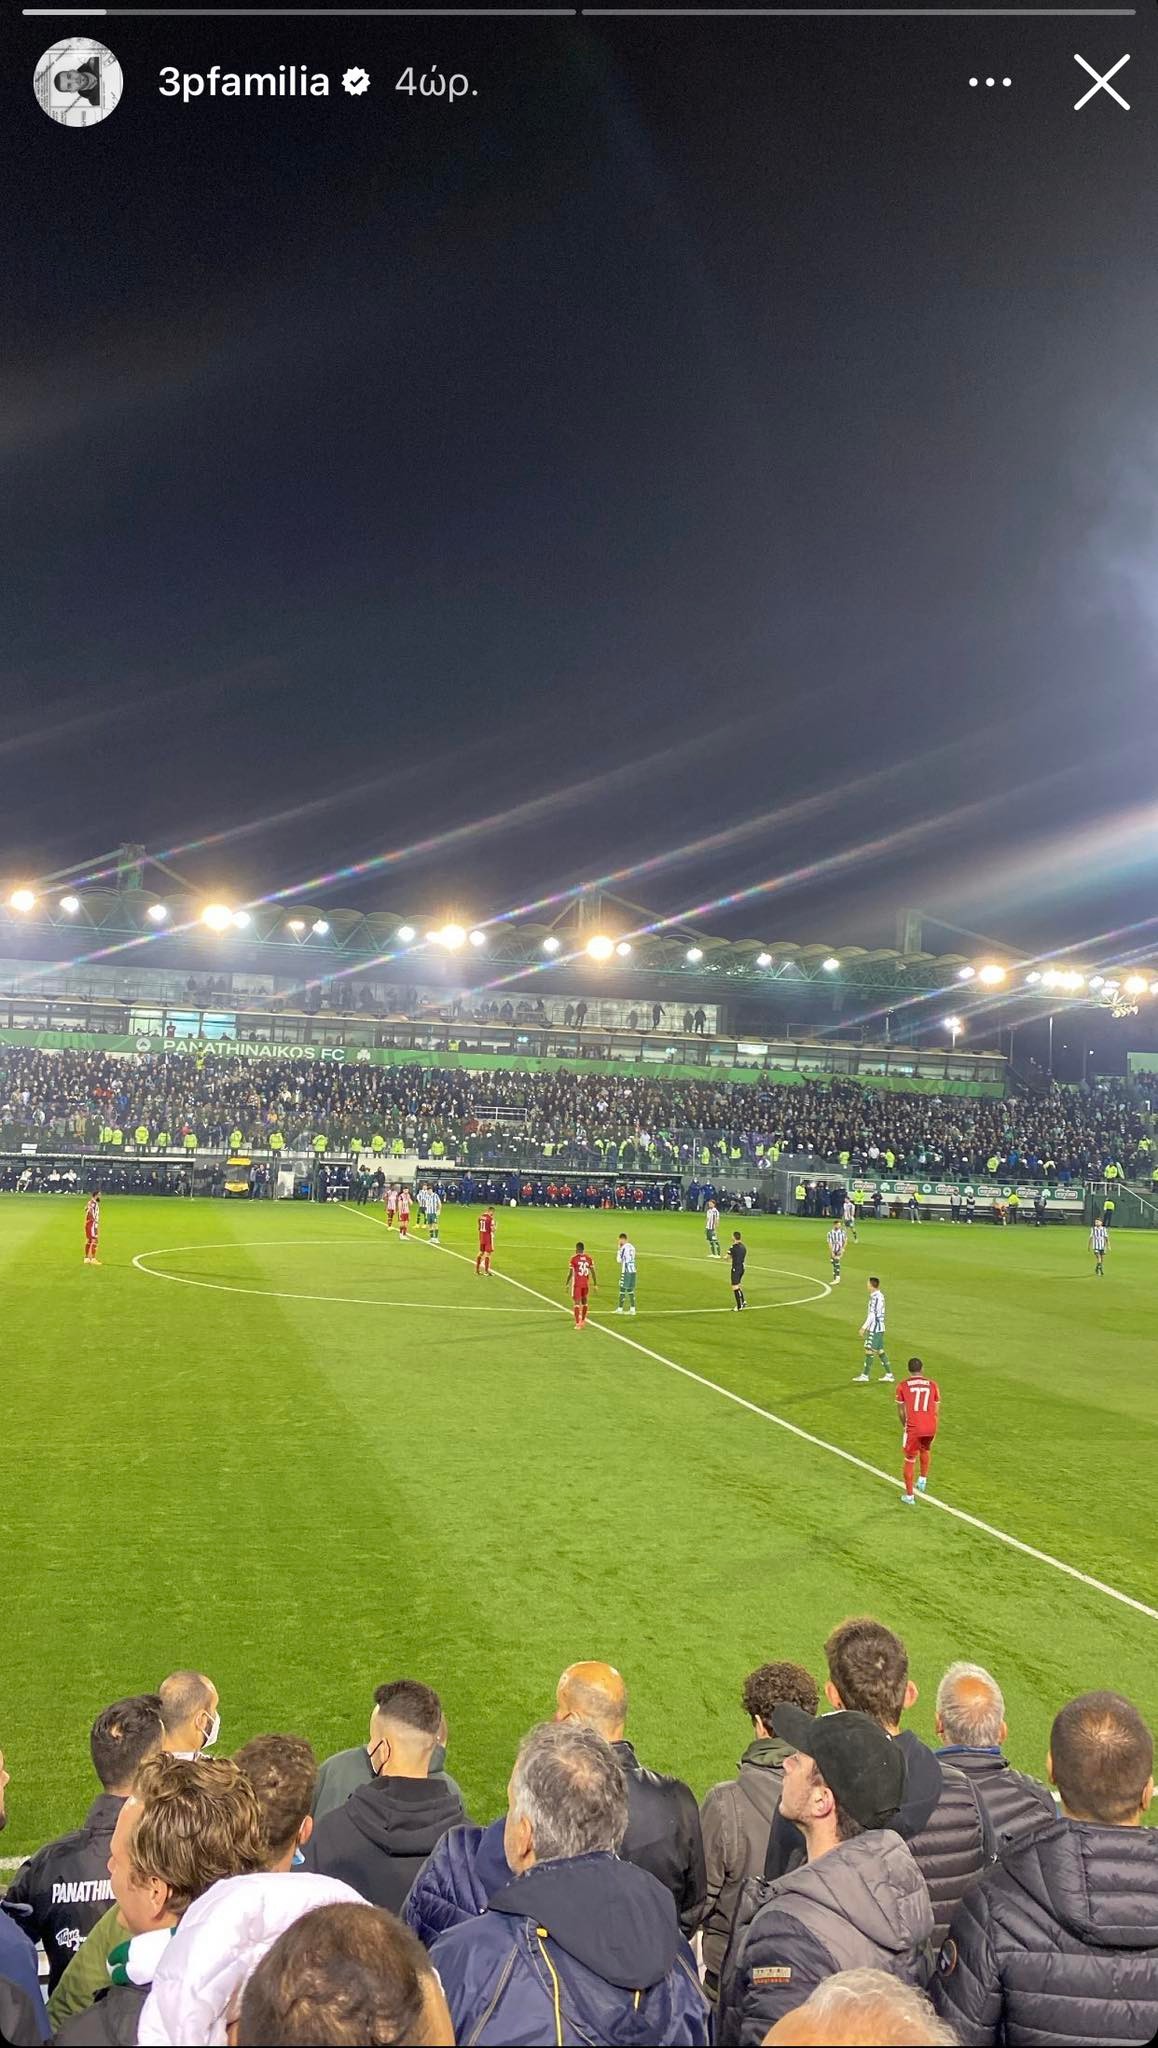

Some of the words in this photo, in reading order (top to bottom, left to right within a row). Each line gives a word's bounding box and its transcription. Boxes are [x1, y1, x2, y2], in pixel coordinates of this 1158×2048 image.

[163, 1040, 316, 1059] PANATHINAIKOS
[320, 1048, 345, 1061] FC
[577, 1261, 590, 1277] 36
[909, 1387, 930, 1412] 77
